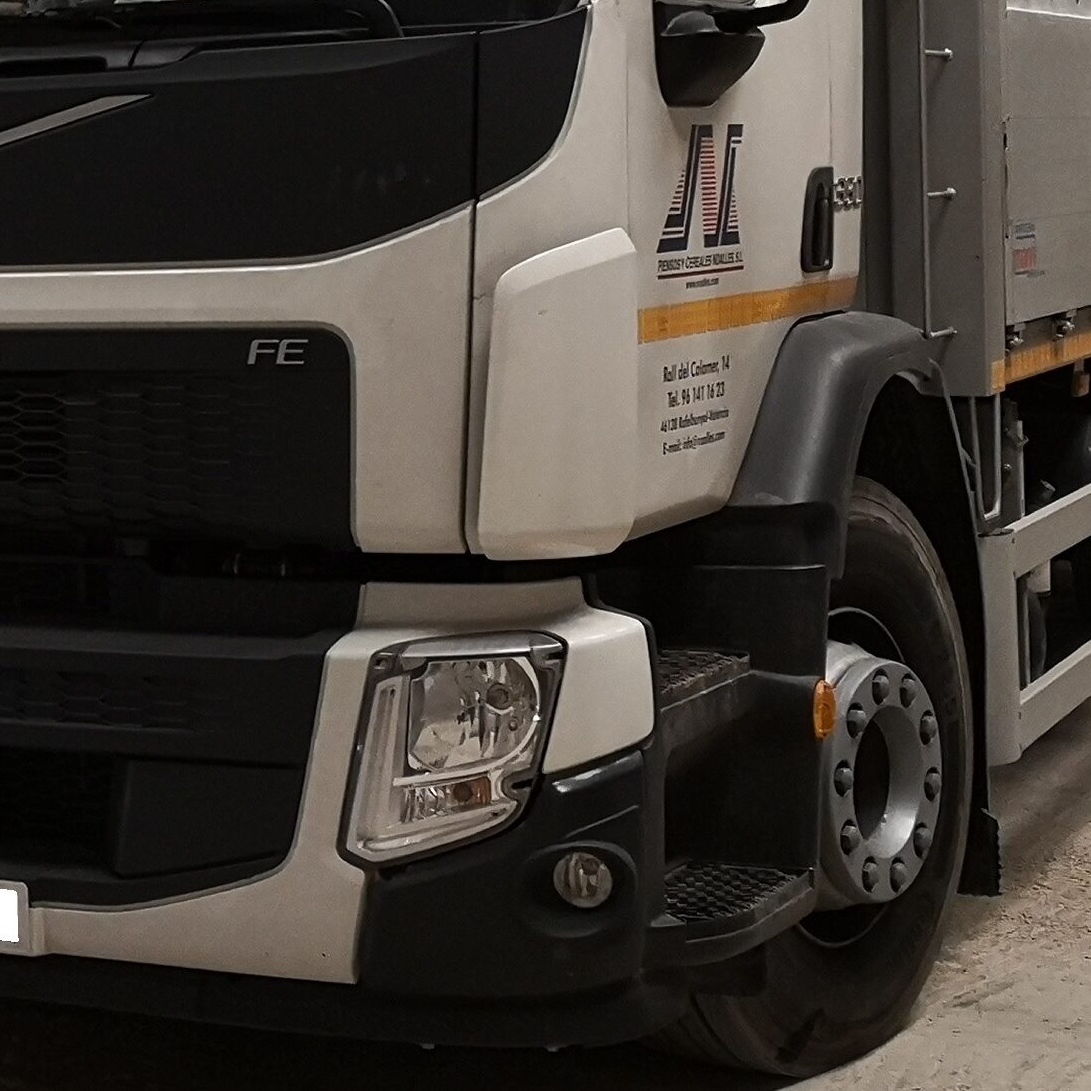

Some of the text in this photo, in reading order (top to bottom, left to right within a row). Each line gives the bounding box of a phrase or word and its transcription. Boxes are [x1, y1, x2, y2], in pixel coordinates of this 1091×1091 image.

[247, 339, 309, 365] FE
[679, 362, 689, 380] del
[722, 355, 729, 370] 14
[668, 381, 724, 407] Tel. 96 141 16 23
